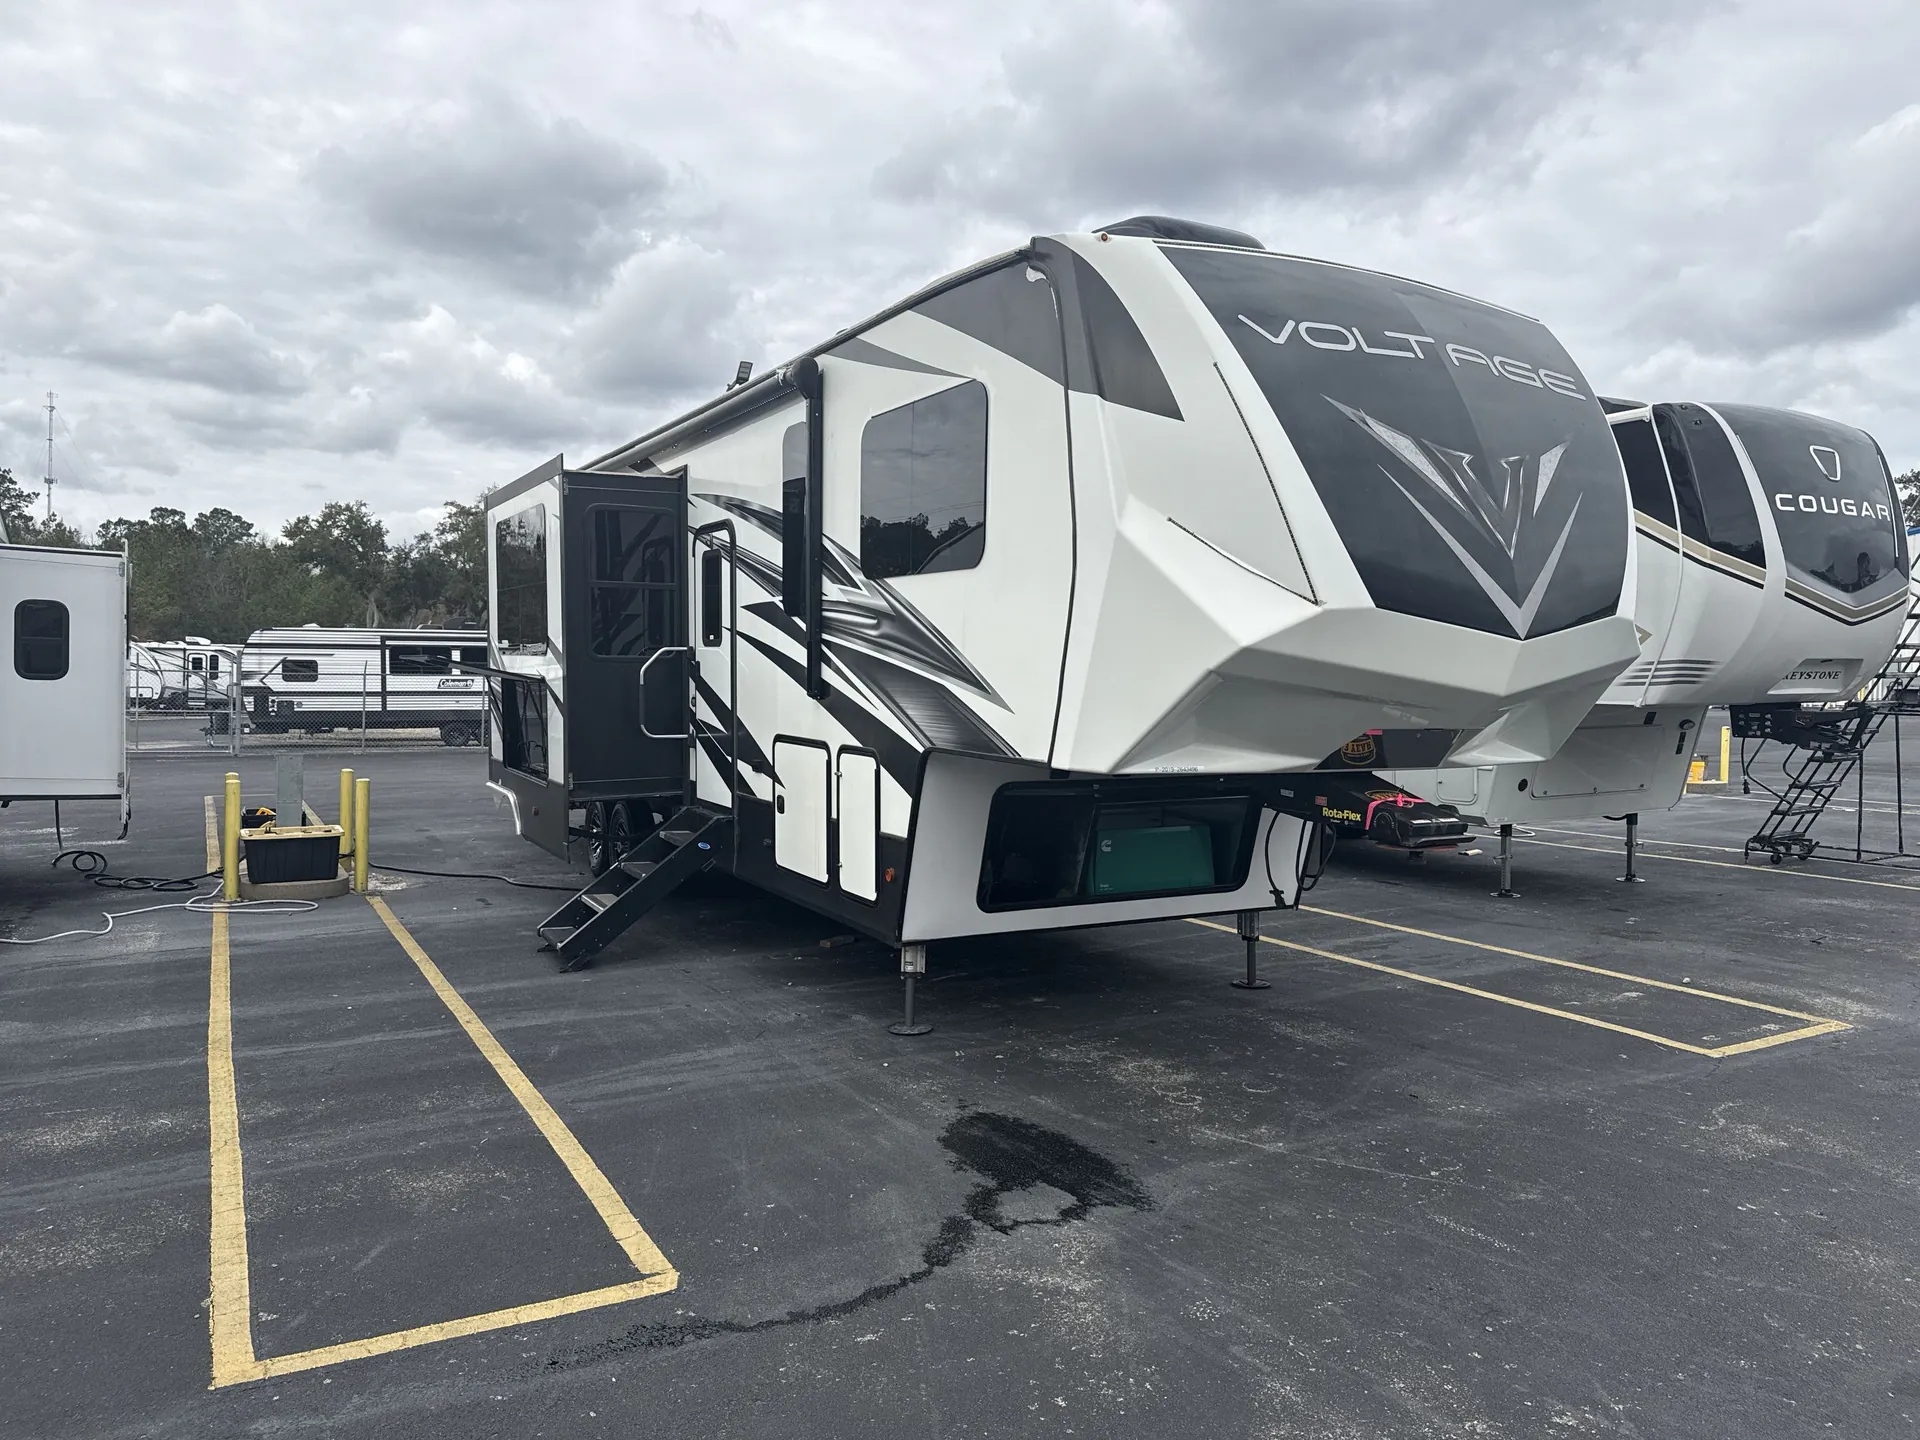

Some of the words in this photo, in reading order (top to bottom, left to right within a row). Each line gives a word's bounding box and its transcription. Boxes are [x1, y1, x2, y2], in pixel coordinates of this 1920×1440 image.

[1237, 313, 1587, 401] VOLTAGE
[1774, 493, 1891, 522] COUGAR
[440, 679, 467, 687] Coleman
[1322, 806, 1362, 822] Rota-Flex
